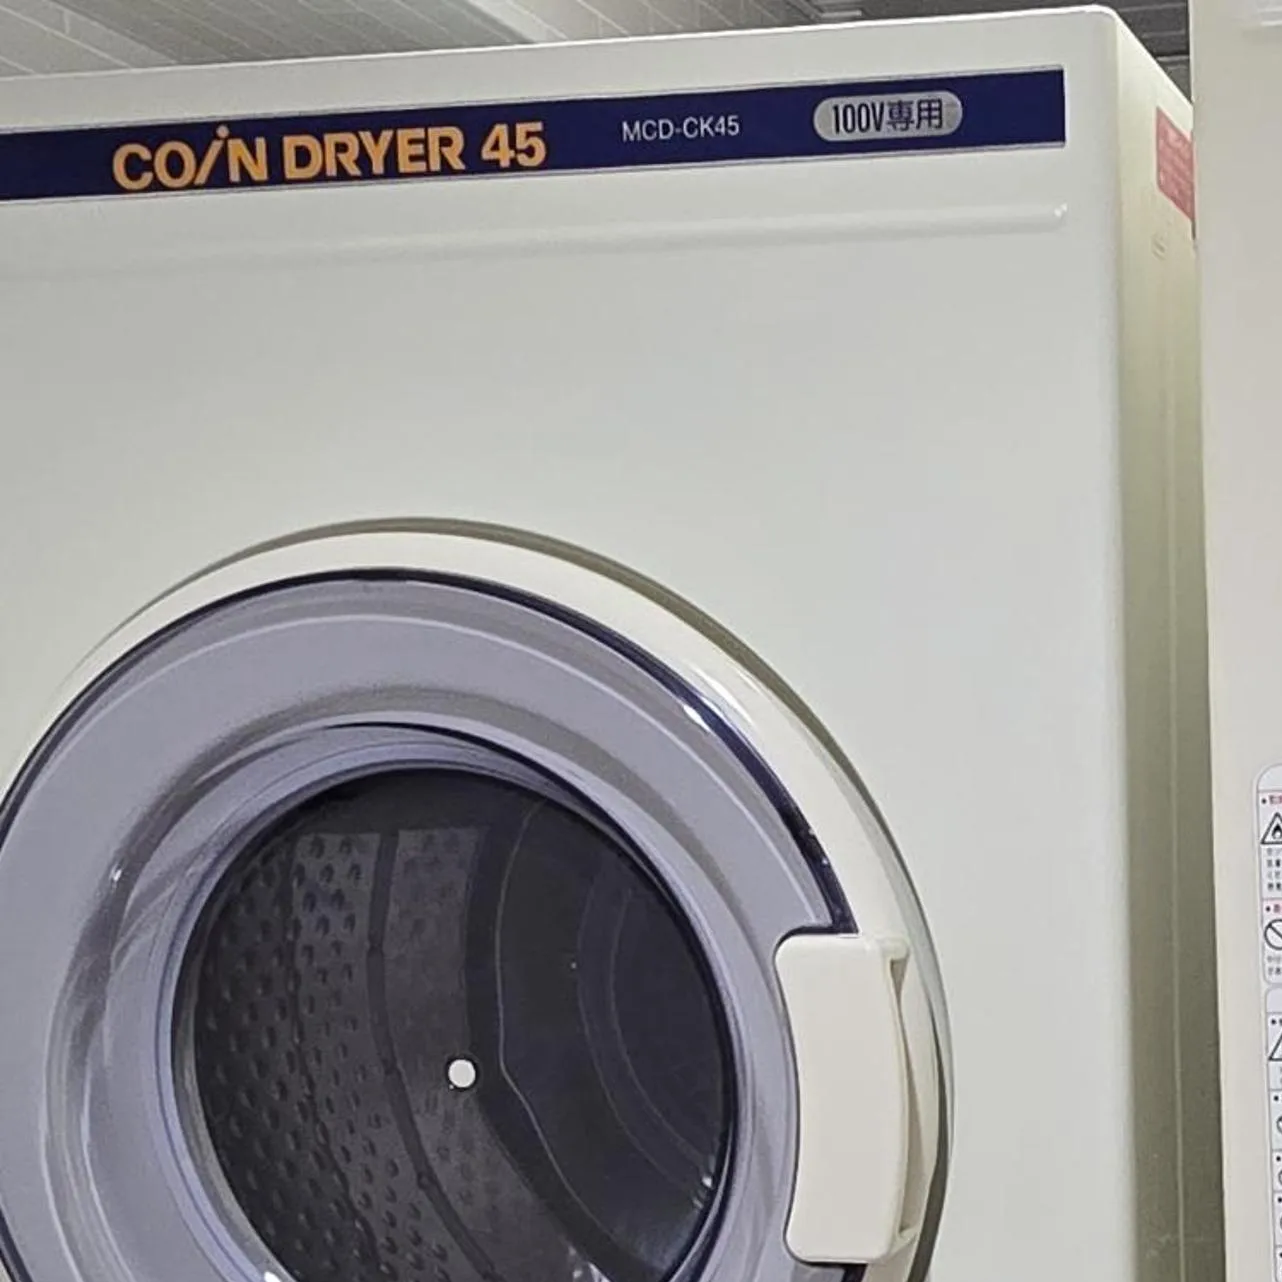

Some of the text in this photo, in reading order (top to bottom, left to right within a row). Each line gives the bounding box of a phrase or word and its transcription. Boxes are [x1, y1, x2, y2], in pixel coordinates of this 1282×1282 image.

[621, 114, 741, 144] MCD-CK45
[831, 96, 943, 136] 100V専用
[284, 124, 465, 186] DRYER
[481, 121, 547, 170] 45
